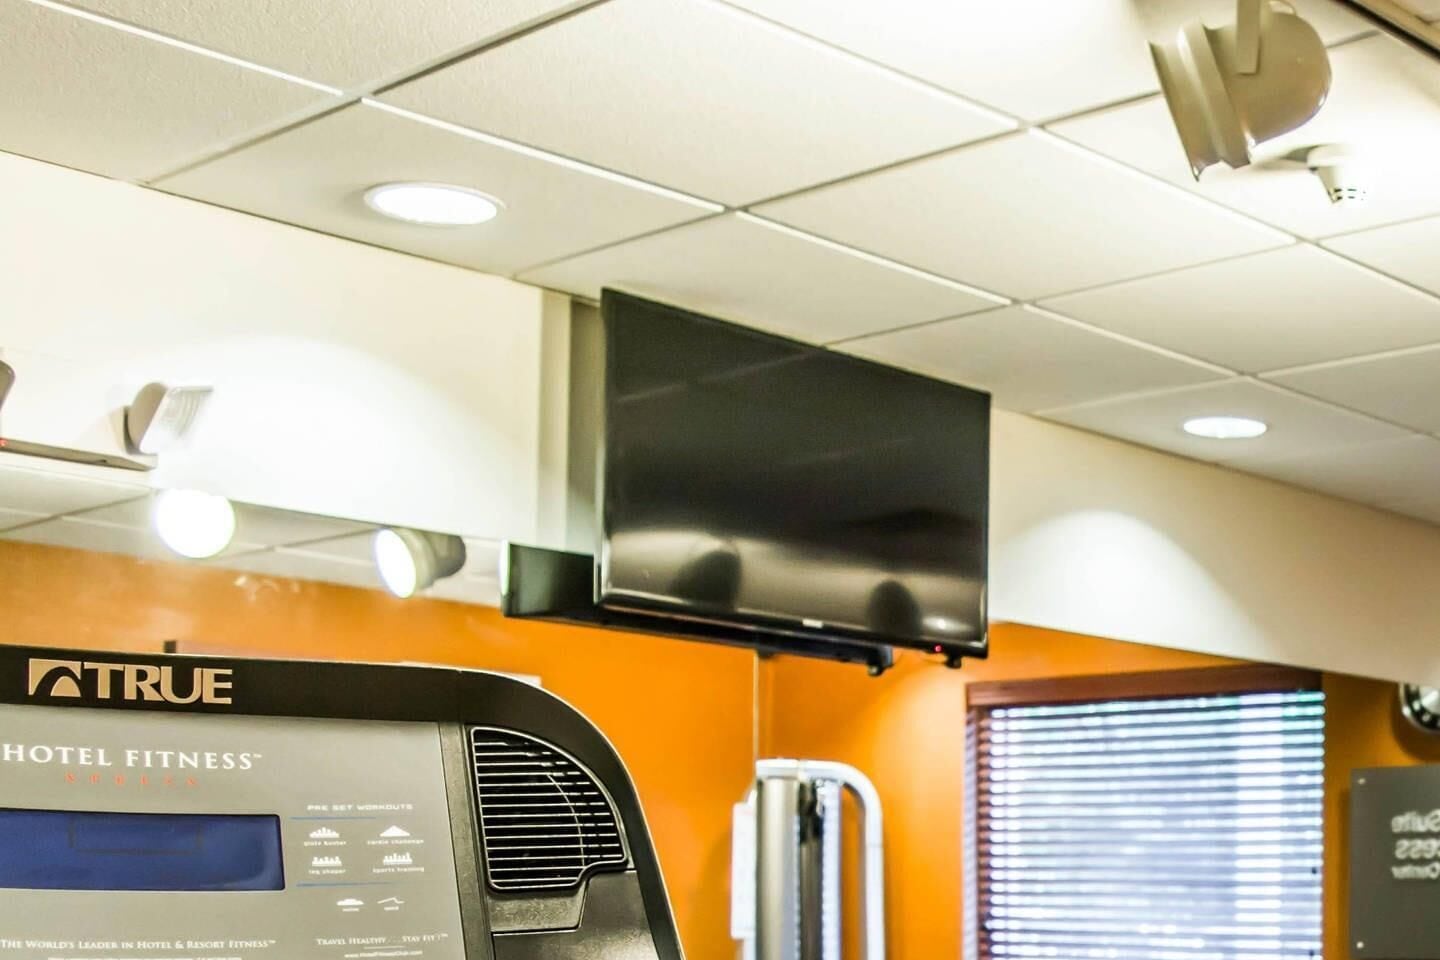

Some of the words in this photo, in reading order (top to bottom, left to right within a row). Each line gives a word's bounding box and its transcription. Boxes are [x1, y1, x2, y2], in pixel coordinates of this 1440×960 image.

[83, 661, 233, 704] TRUE
[1, 743, 113, 766] HOTEL
[356, 803, 413, 811] WORKOUTS
[1, 939, 22, 949] THE
[79, 940, 119, 949] LEADER
[121, 941, 134, 949] IN
[137, 940, 172, 949] HOTEL
[174, 940, 185, 949] &
[186, 940, 226, 949] RESORT
